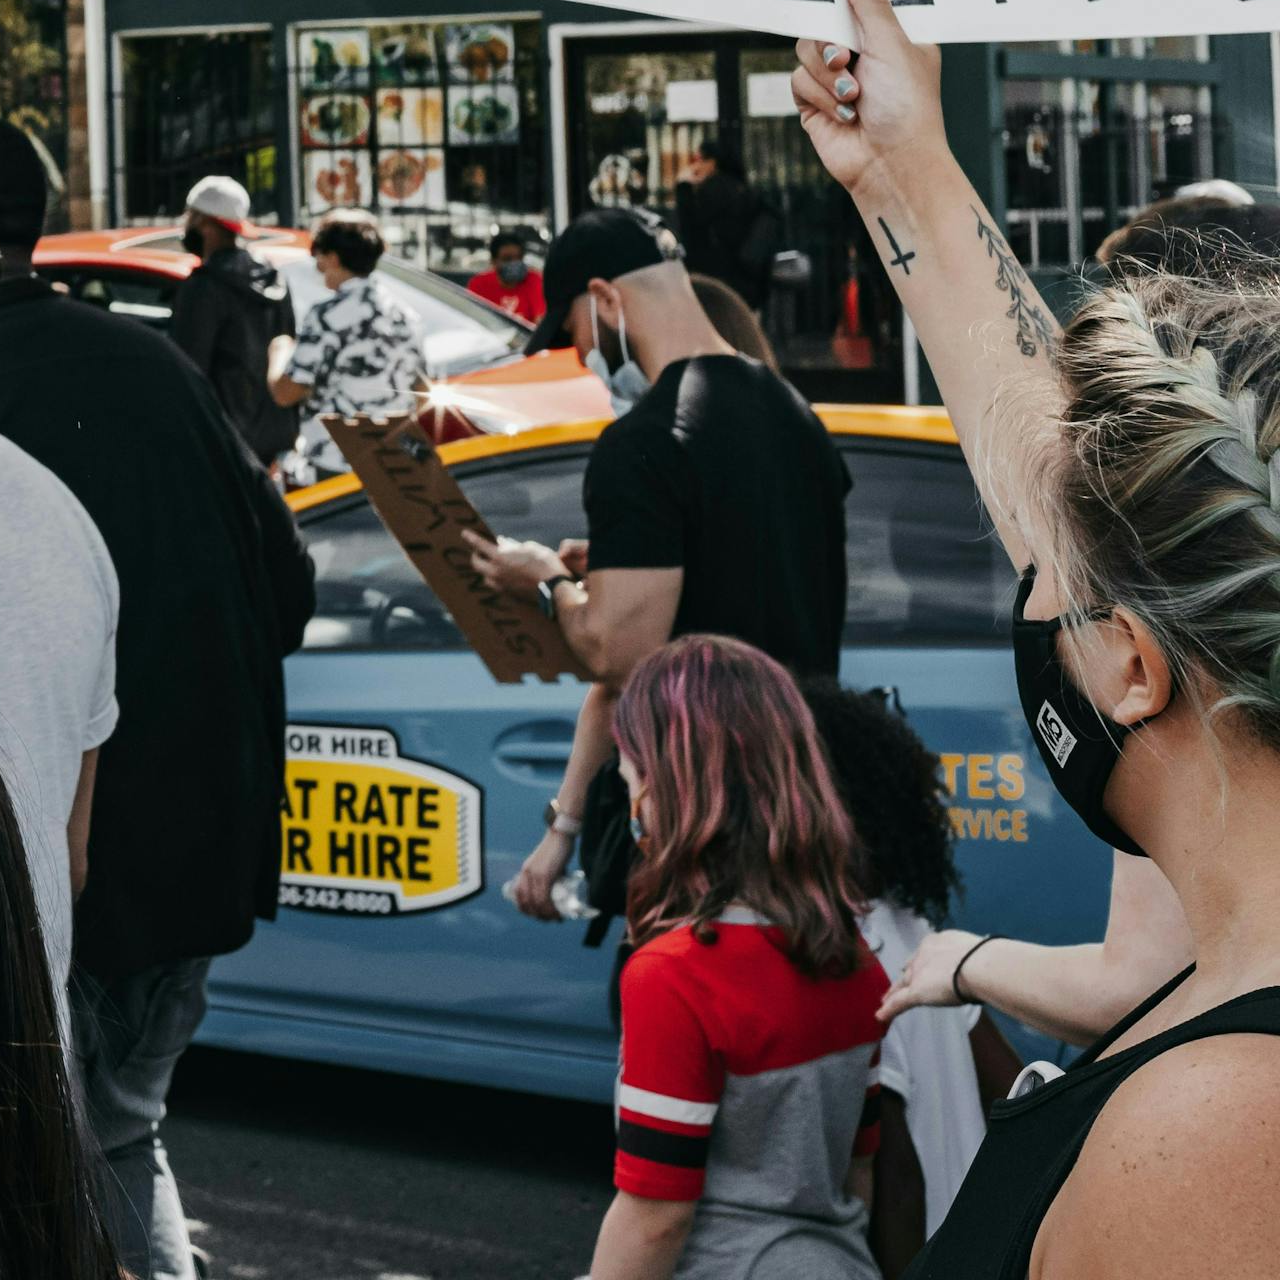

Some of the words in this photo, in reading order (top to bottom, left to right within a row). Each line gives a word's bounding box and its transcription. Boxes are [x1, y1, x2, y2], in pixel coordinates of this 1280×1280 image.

[331, 735, 391, 758] HIRE
[334, 781, 440, 830] RATE
[328, 830, 432, 881] HIRE
